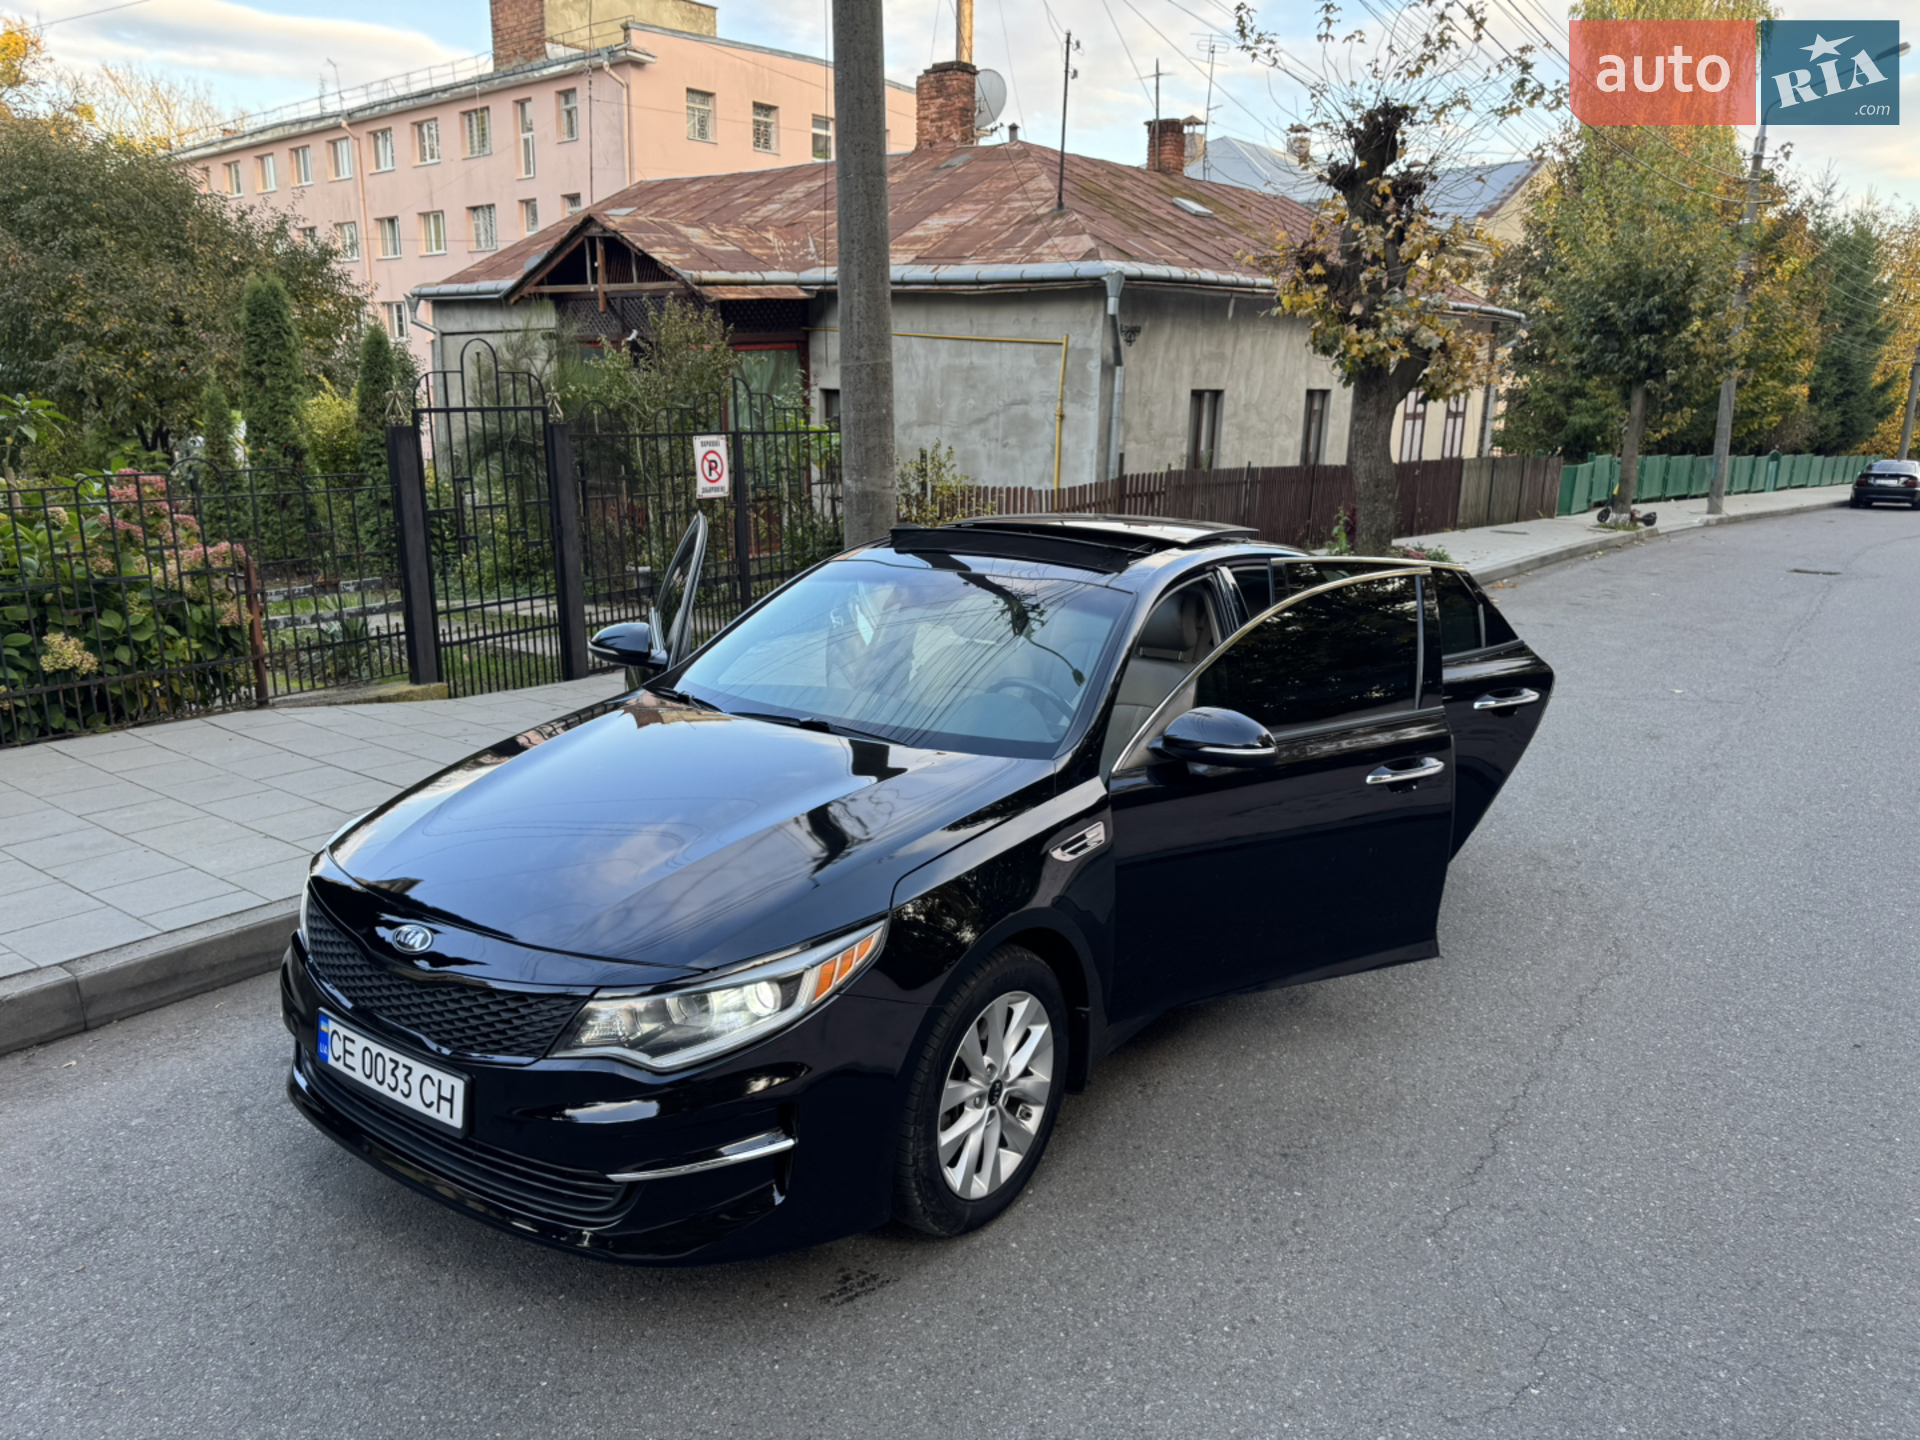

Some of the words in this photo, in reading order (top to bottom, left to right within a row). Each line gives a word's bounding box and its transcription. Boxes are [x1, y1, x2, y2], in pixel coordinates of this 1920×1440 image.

[708, 459, 718, 477] P
[396, 928, 425, 949] KIA
[330, 1029, 357, 1073] CE
[361, 1046, 413, 1099] 0033
[419, 1074, 455, 1119] CH
[992, 1082, 1001, 1104] KIA
